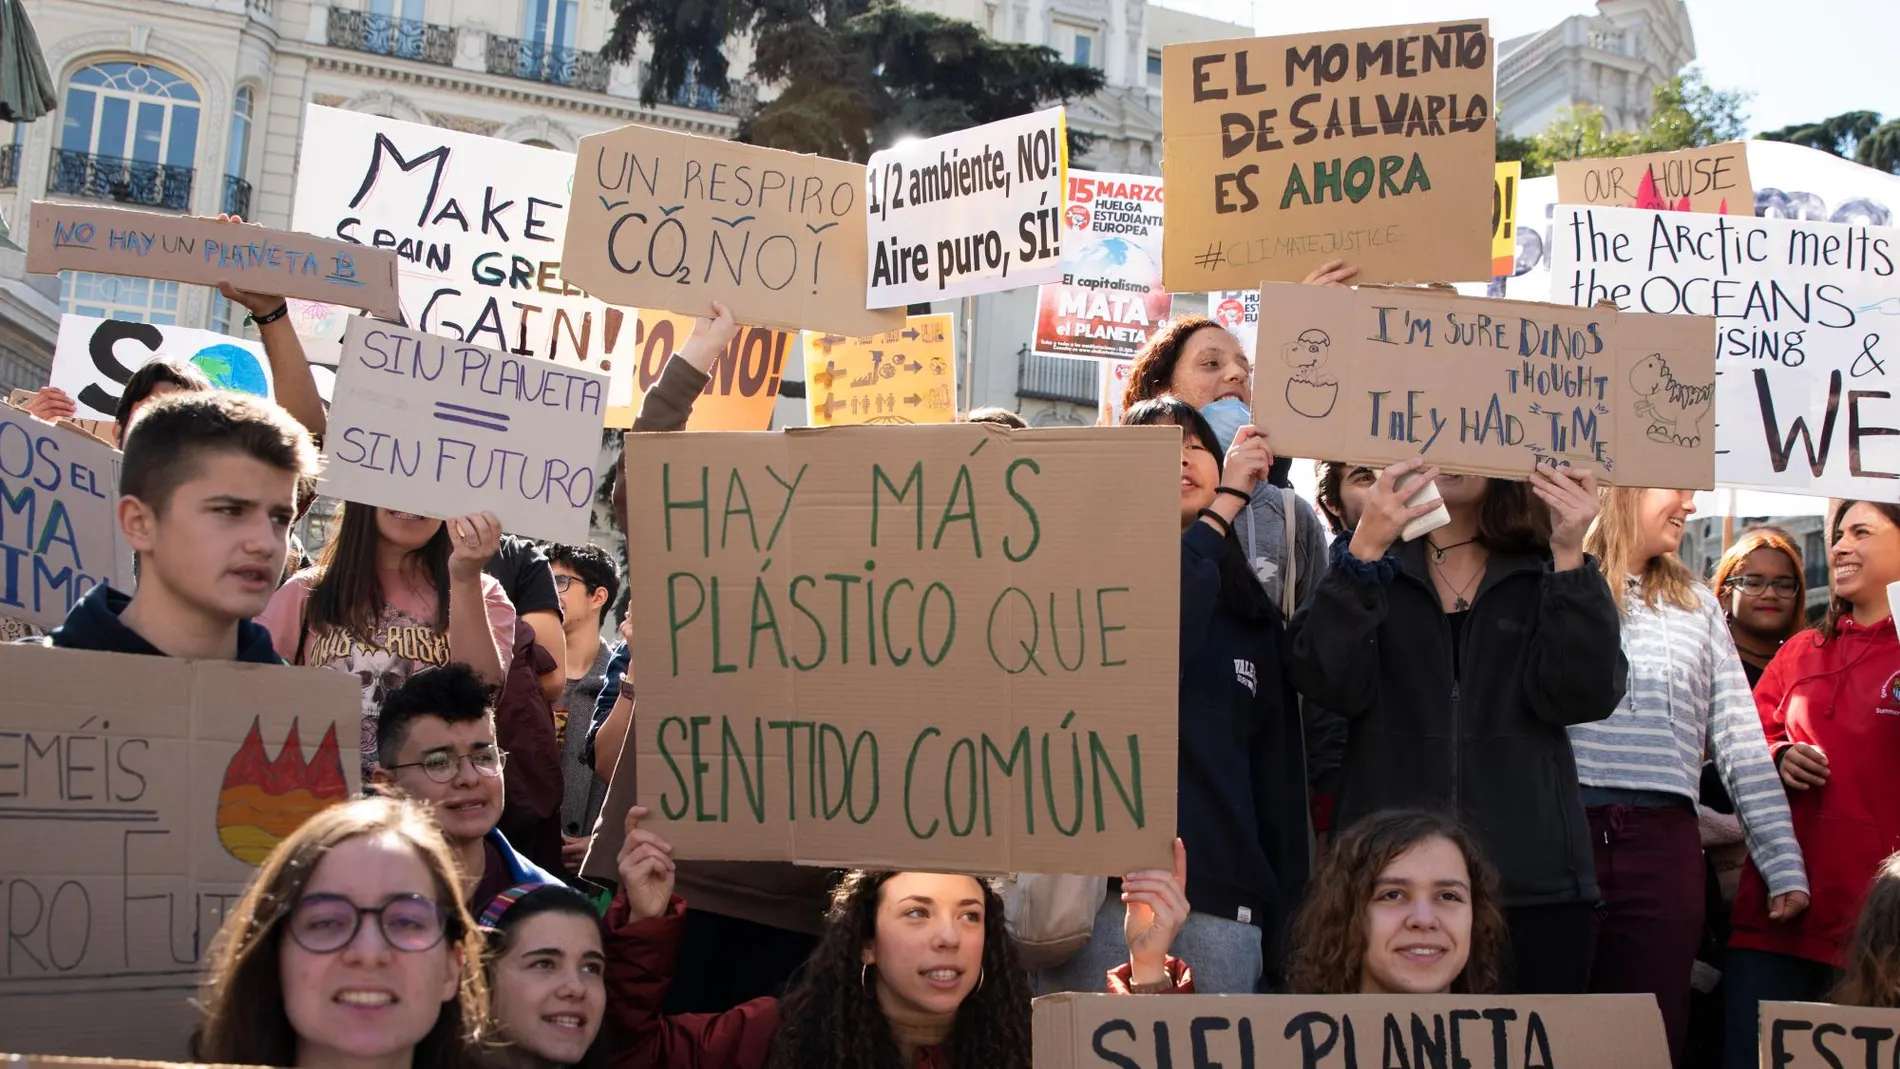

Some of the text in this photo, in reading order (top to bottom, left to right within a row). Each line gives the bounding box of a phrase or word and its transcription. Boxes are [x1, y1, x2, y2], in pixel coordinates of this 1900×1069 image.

[1192, 24, 1488, 103] EL MOMENTO
[1220, 93, 1488, 160] DE SALVARLO
[597, 146, 854, 217] UN RESPIRO
[869, 127, 1058, 221] 1/2 ambiente, NO!
[1068, 177, 1094, 203] 15
[1214, 151, 1431, 214] ES AHORA
[1584, 155, 1736, 203] OUR HOUSE
[1092, 221, 1148, 237] EUROPEA
[1093, 210, 1163, 227] ESTUDIANTI
[1095, 199, 1143, 213] HUELGA
[53, 220, 359, 279] NO HAY UN PLANETA B
[871, 191, 1060, 290] Aire puro, SÍ!
[1569, 210, 1633, 263] the
[1788, 226, 1894, 277] melts
[472, 252, 590, 298] GRE
[1062, 273, 1150, 294] El capitalismo
[1640, 276, 1856, 329] OCEANS
[338, 288, 625, 372] GAIN!
[1058, 291, 1150, 327] MATA
[1073, 323, 1147, 344] PLANETA
[1366, 306, 1434, 348] I'M
[1445, 312, 1510, 350] SURE
[359, 330, 602, 416] SIN PLANETA
[1505, 360, 1609, 401] THOUGHT
[1850, 333, 1886, 377] &
[1460, 393, 1525, 446] HAD
[71, 461, 106, 499] EL
[336, 427, 594, 508] SIN FUTURO
[662, 437, 1042, 563] HAY MÁS
[987, 587, 1130, 677] QUE
[656, 710, 1146, 840] SENTIDO COMÚN
[0, 878, 92, 976] RO
